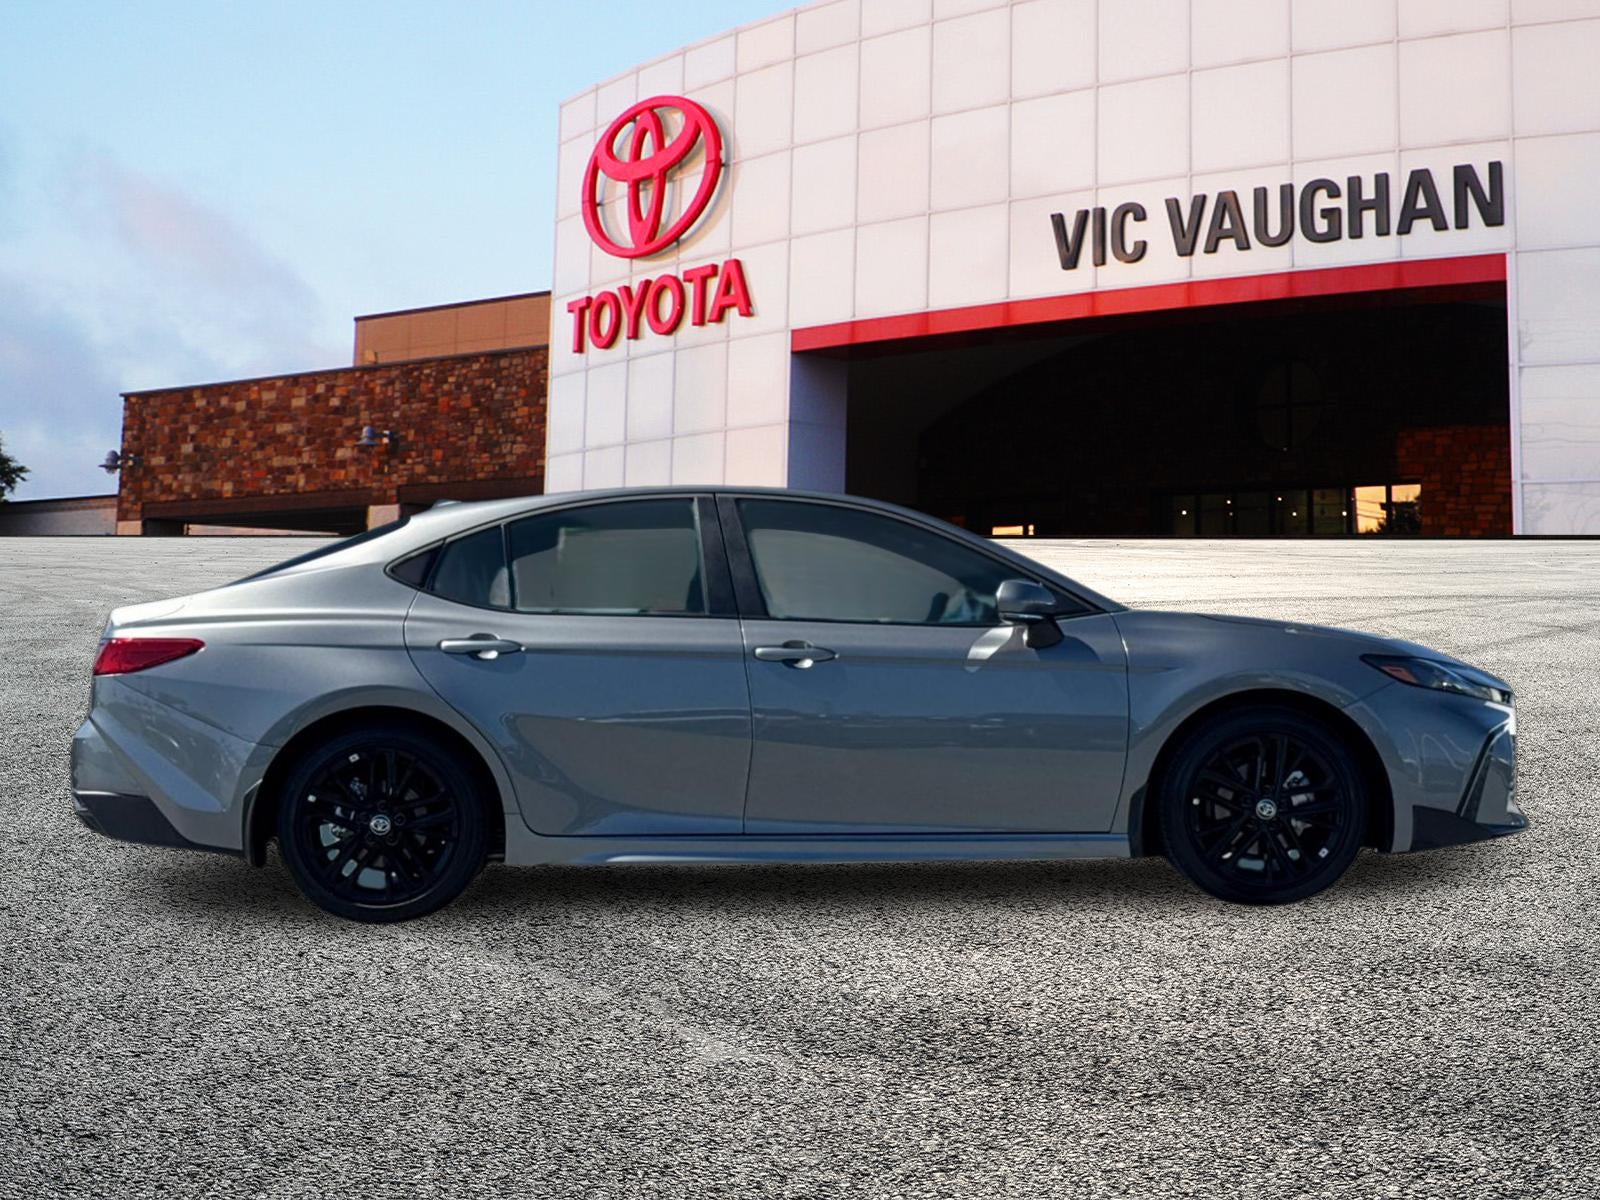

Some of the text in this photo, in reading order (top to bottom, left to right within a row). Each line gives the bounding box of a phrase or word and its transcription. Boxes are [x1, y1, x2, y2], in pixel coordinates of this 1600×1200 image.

[1050, 160, 1505, 270] VIC VAUGHAN
[567, 259, 754, 354] TOYOTA
